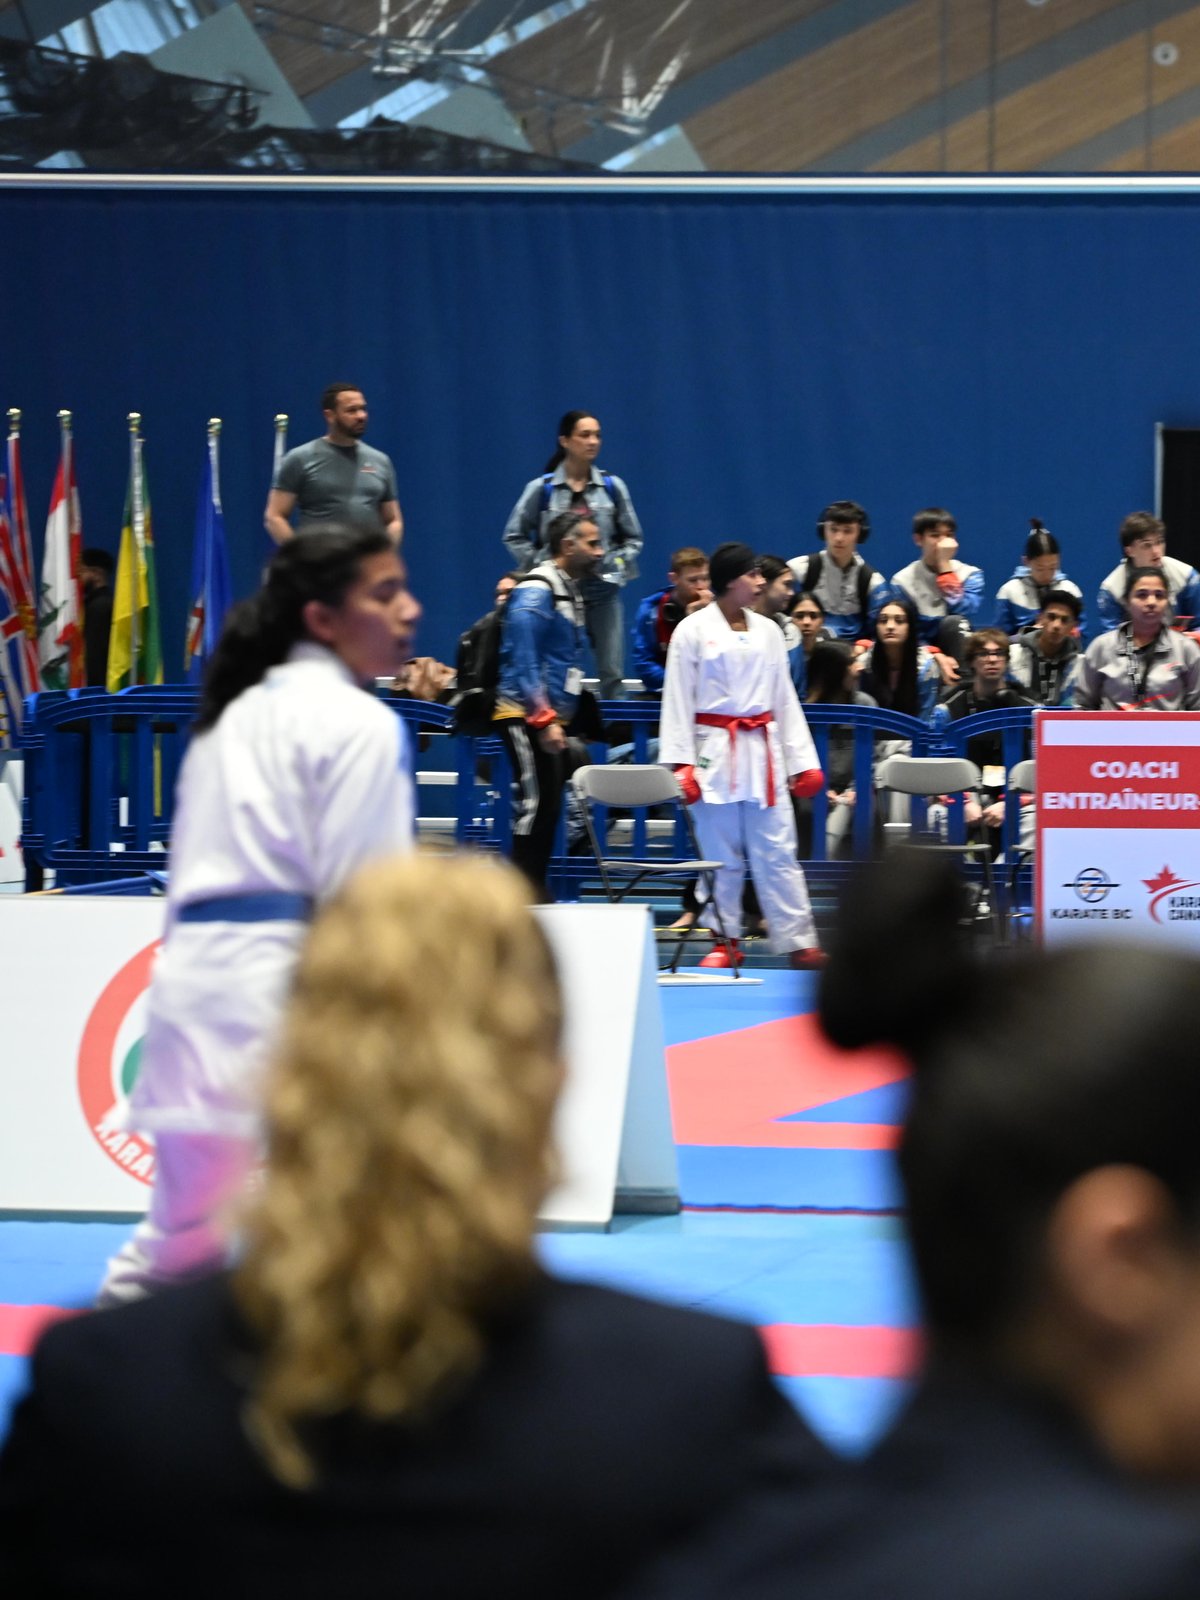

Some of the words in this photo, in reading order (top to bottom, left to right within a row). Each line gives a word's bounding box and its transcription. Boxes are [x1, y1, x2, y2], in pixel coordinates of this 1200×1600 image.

[1090, 761, 1179, 779] COACH
[1051, 908, 1107, 919] KARATE
[1112, 908, 1132, 919] BC
